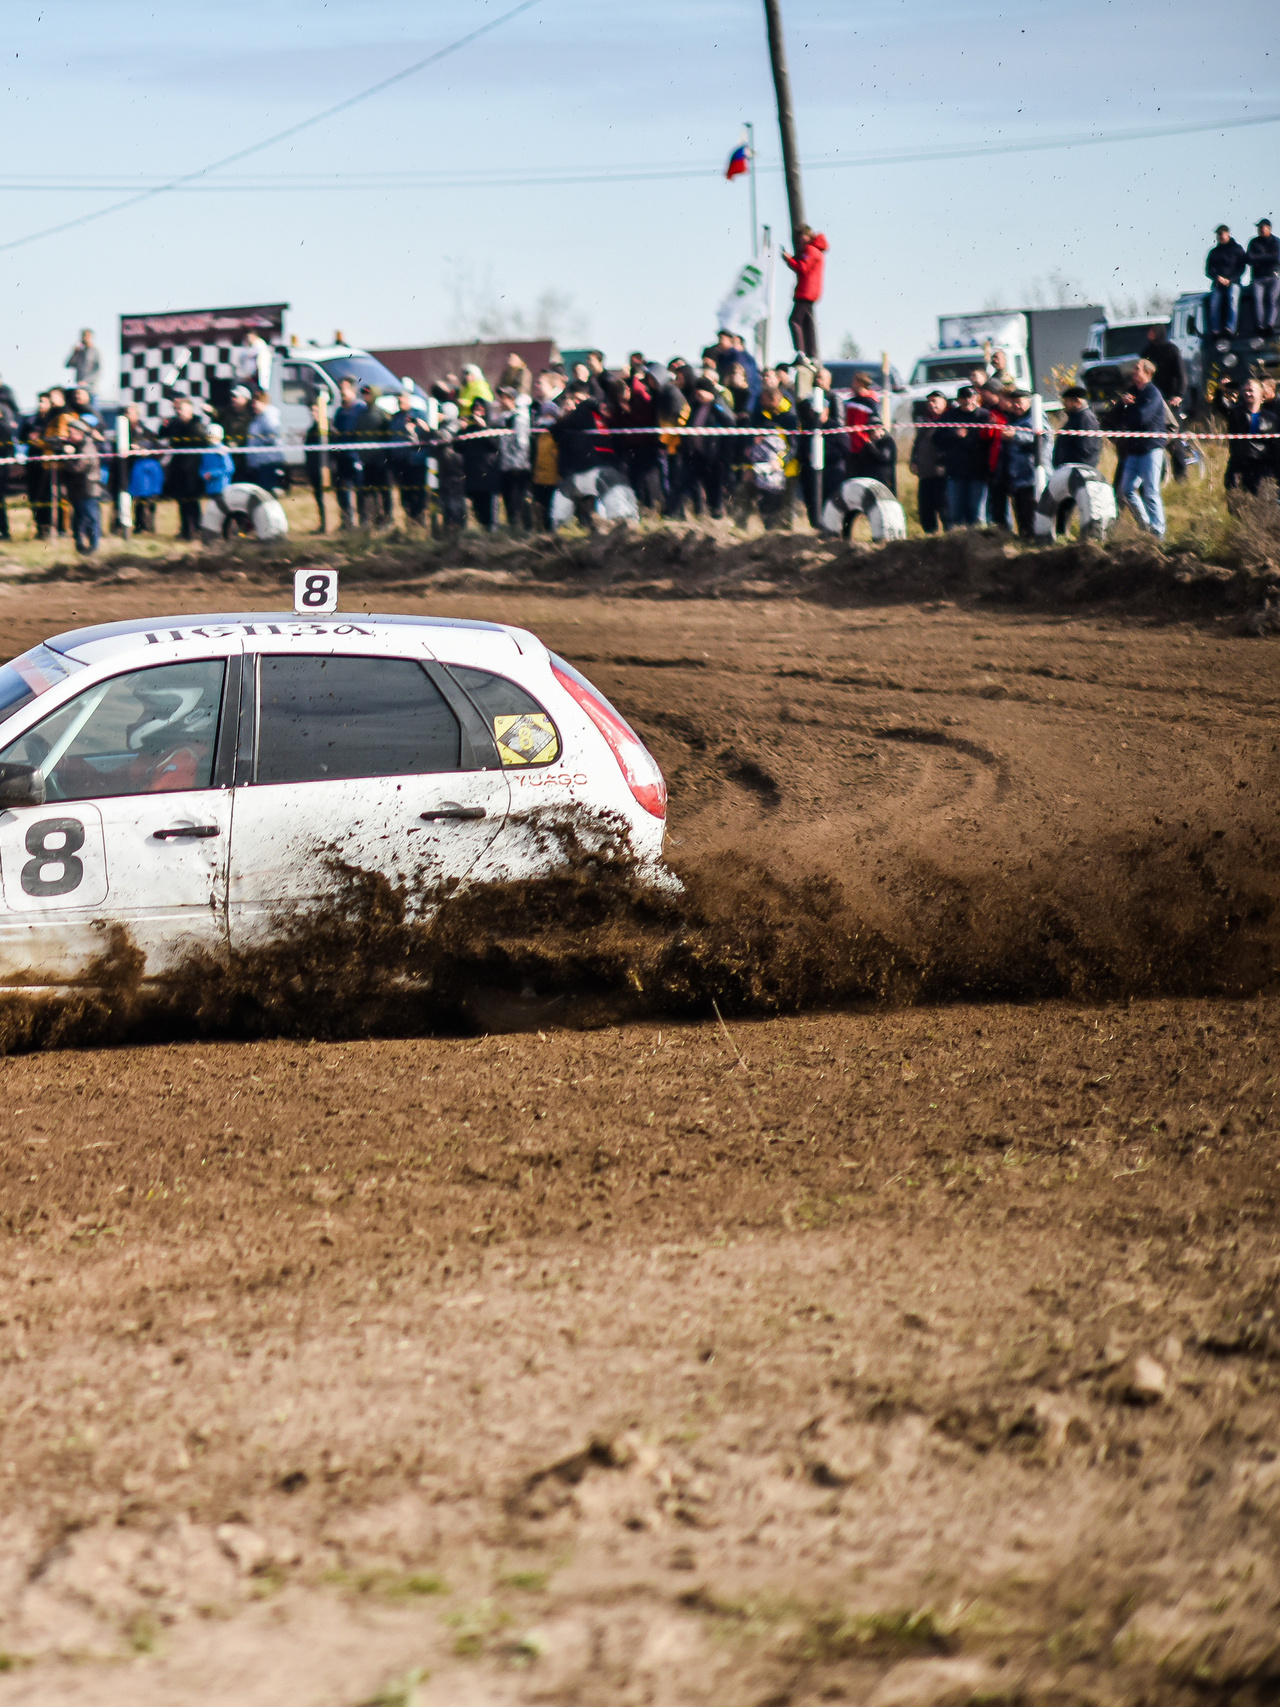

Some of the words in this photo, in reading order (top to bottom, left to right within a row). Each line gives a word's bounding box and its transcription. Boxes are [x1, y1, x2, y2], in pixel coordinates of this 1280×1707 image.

[302, 575, 330, 606] 8
[518, 726, 534, 750] 8
[21, 817, 85, 897] 8
